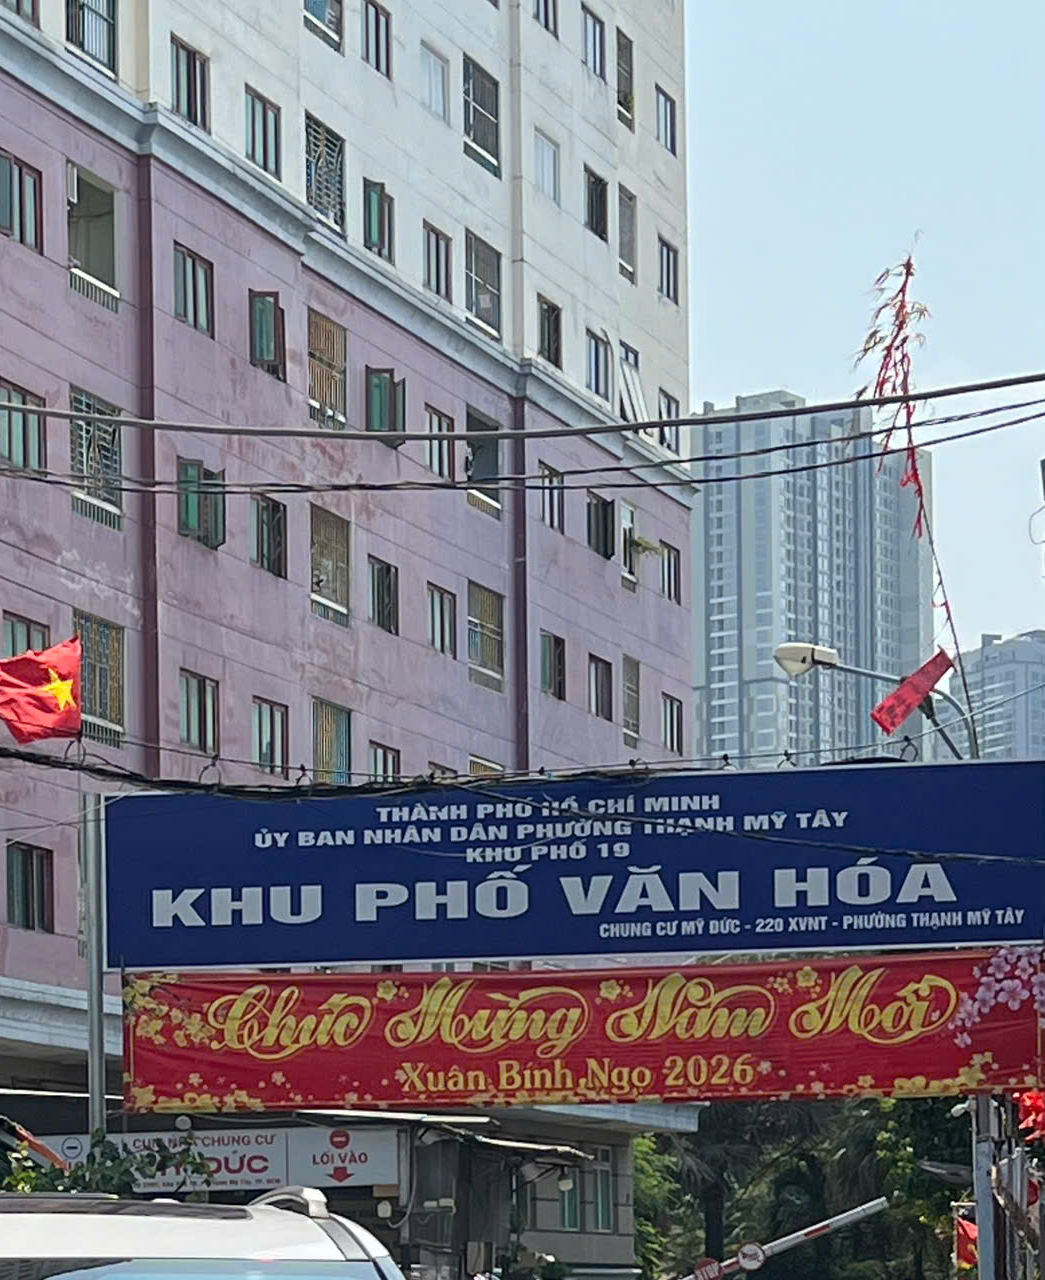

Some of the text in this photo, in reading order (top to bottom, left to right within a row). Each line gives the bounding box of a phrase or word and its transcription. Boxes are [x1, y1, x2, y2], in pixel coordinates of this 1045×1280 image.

[376, 802, 467, 822] THÀNH
[588, 795, 635, 814] CHÍ
[645, 795, 720, 812] MINH
[254, 828, 289, 848] ỦY
[298, 830, 354, 846] BAN
[363, 825, 441, 844] NHÂN
[450, 822, 507, 842] DÂN
[517, 818, 632, 839] PHƯỜNG
[743, 811, 787, 831] MỸ
[795, 809, 848, 829] TÂY
[466, 838, 630, 863] KHU PHỐ 19
[152, 856, 957, 927] KHU PHỐ VĂN HÓA
[599, 921, 652, 938] CHUNG
[656, 920, 678, 936] CƯ
[681, 917, 705, 936] MỸ
[709, 916, 741, 935] ĐỨC
[756, 918, 784, 933] 220
[788, 916, 828, 932] XVNT
[843, 910, 906, 929] PHƯỜNG
[911, 911, 963, 929] THẠNH
[967, 908, 991, 926] MỸ
[995, 906, 1025, 924] TÂY
[207, 964, 957, 1060] Chúc Mừng Năm Mới
[402, 1053, 755, 1096] Xuân Bính Ngọ 2026
[202, 1134, 252, 1148] CHUNG
[255, 1133, 277, 1146] CƯ
[338, 1150, 368, 1164] VÀO
